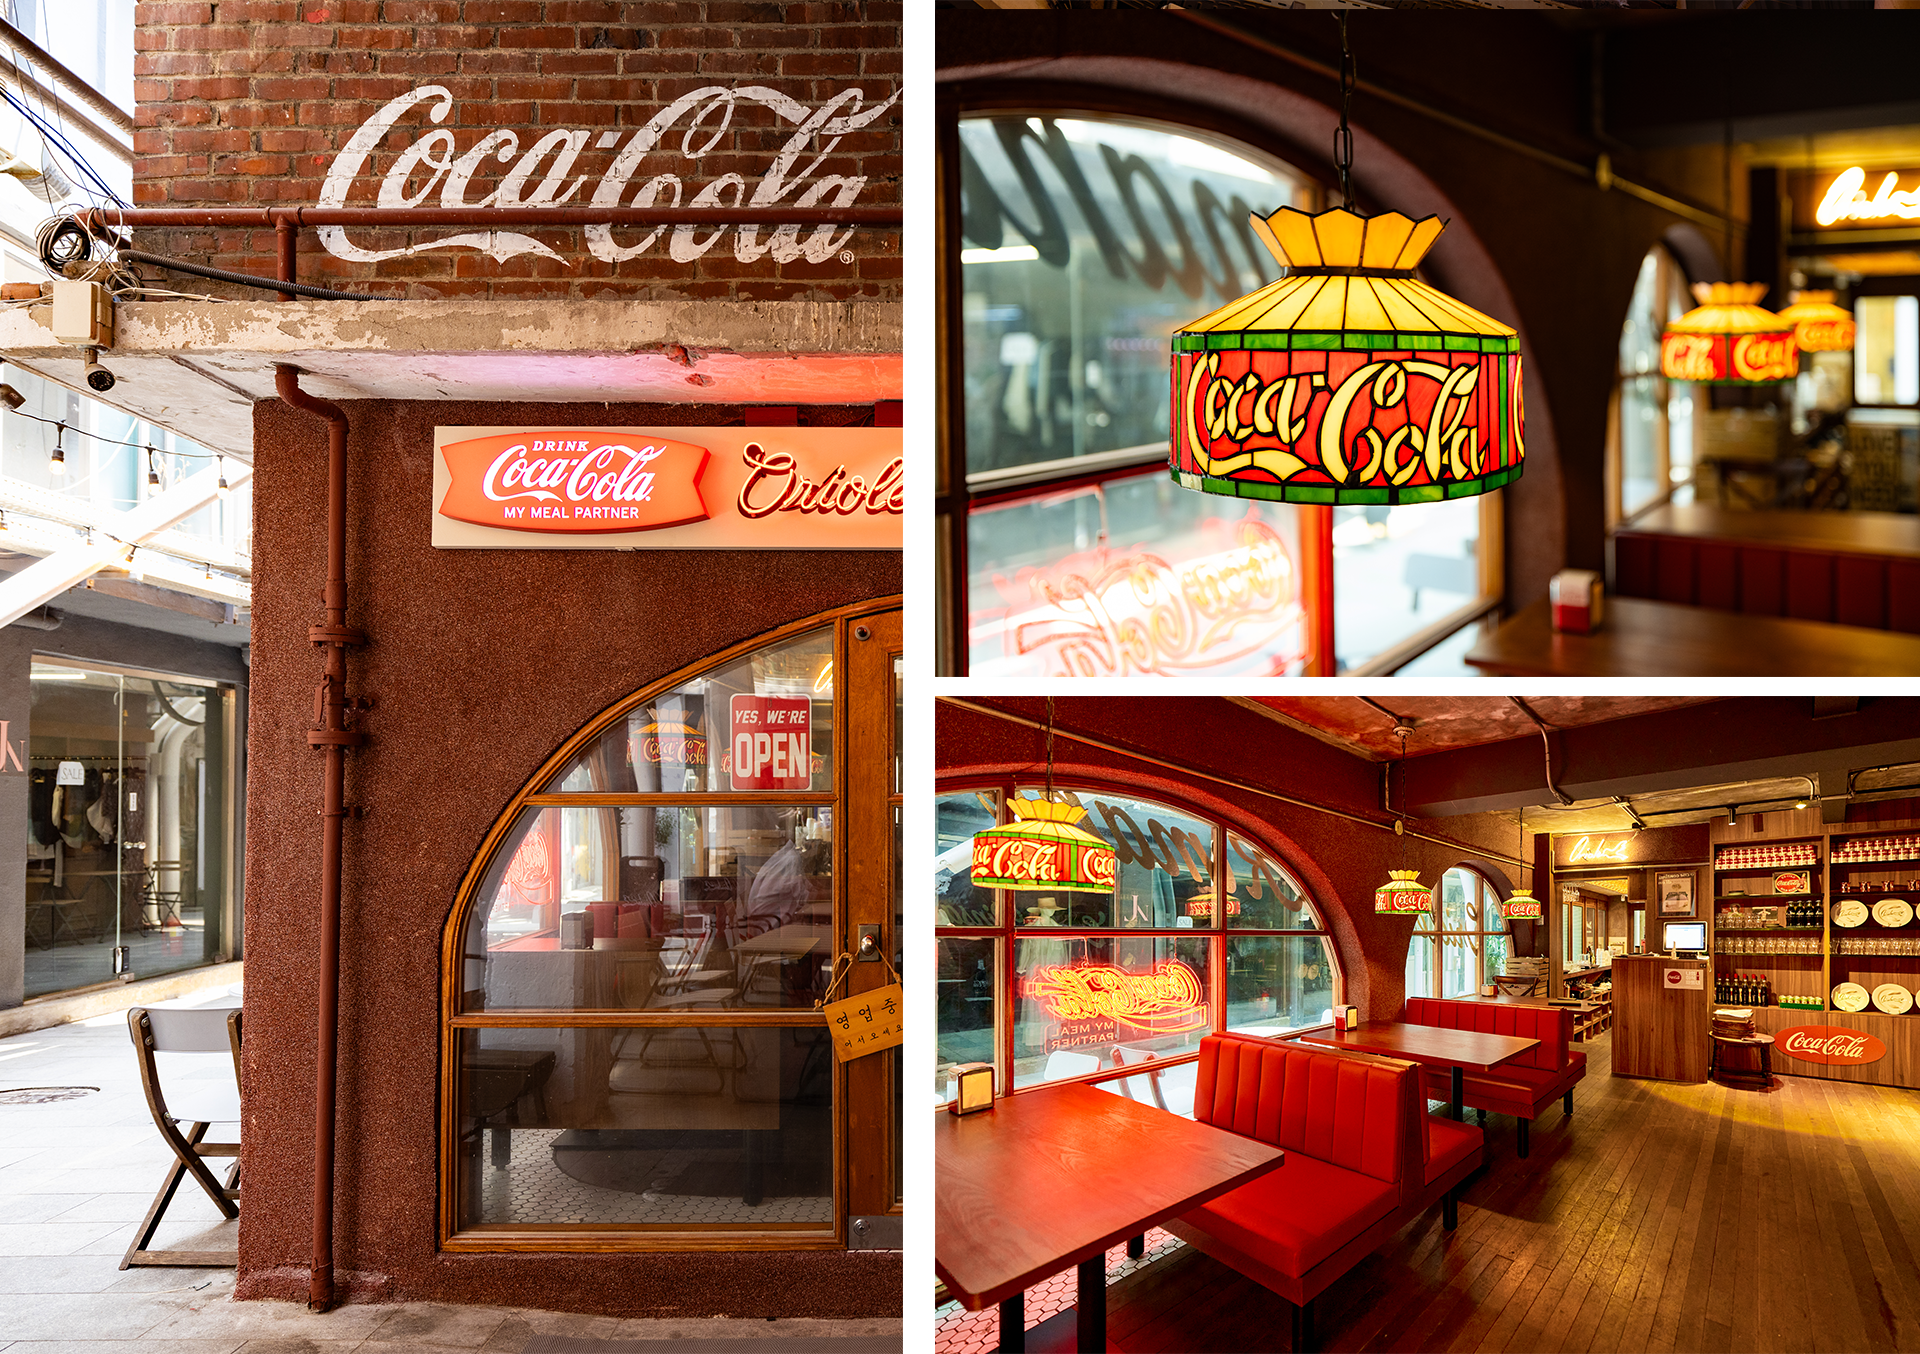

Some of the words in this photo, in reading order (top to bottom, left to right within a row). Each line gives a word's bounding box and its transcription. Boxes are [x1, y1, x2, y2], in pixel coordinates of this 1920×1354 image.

[315, 85, 902, 266] Coca-Cola
[1187, 353, 1487, 485] Coca-Cola
[532, 440, 590, 452] DRINK
[482, 444, 667, 502] Coca-Cola
[504, 506, 526, 518] MY
[530, 506, 569, 518] MEAL
[574, 506, 639, 518] PARTNER
[735, 710, 762, 726] YES,
[767, 710, 807, 724] WE'RE
[735, 733, 807, 778] OPEN
[61, 767, 84, 780] SALE
[836, 998, 897, 1030] 영업중
[1785, 1031, 1869, 1059] Coca-Cola
